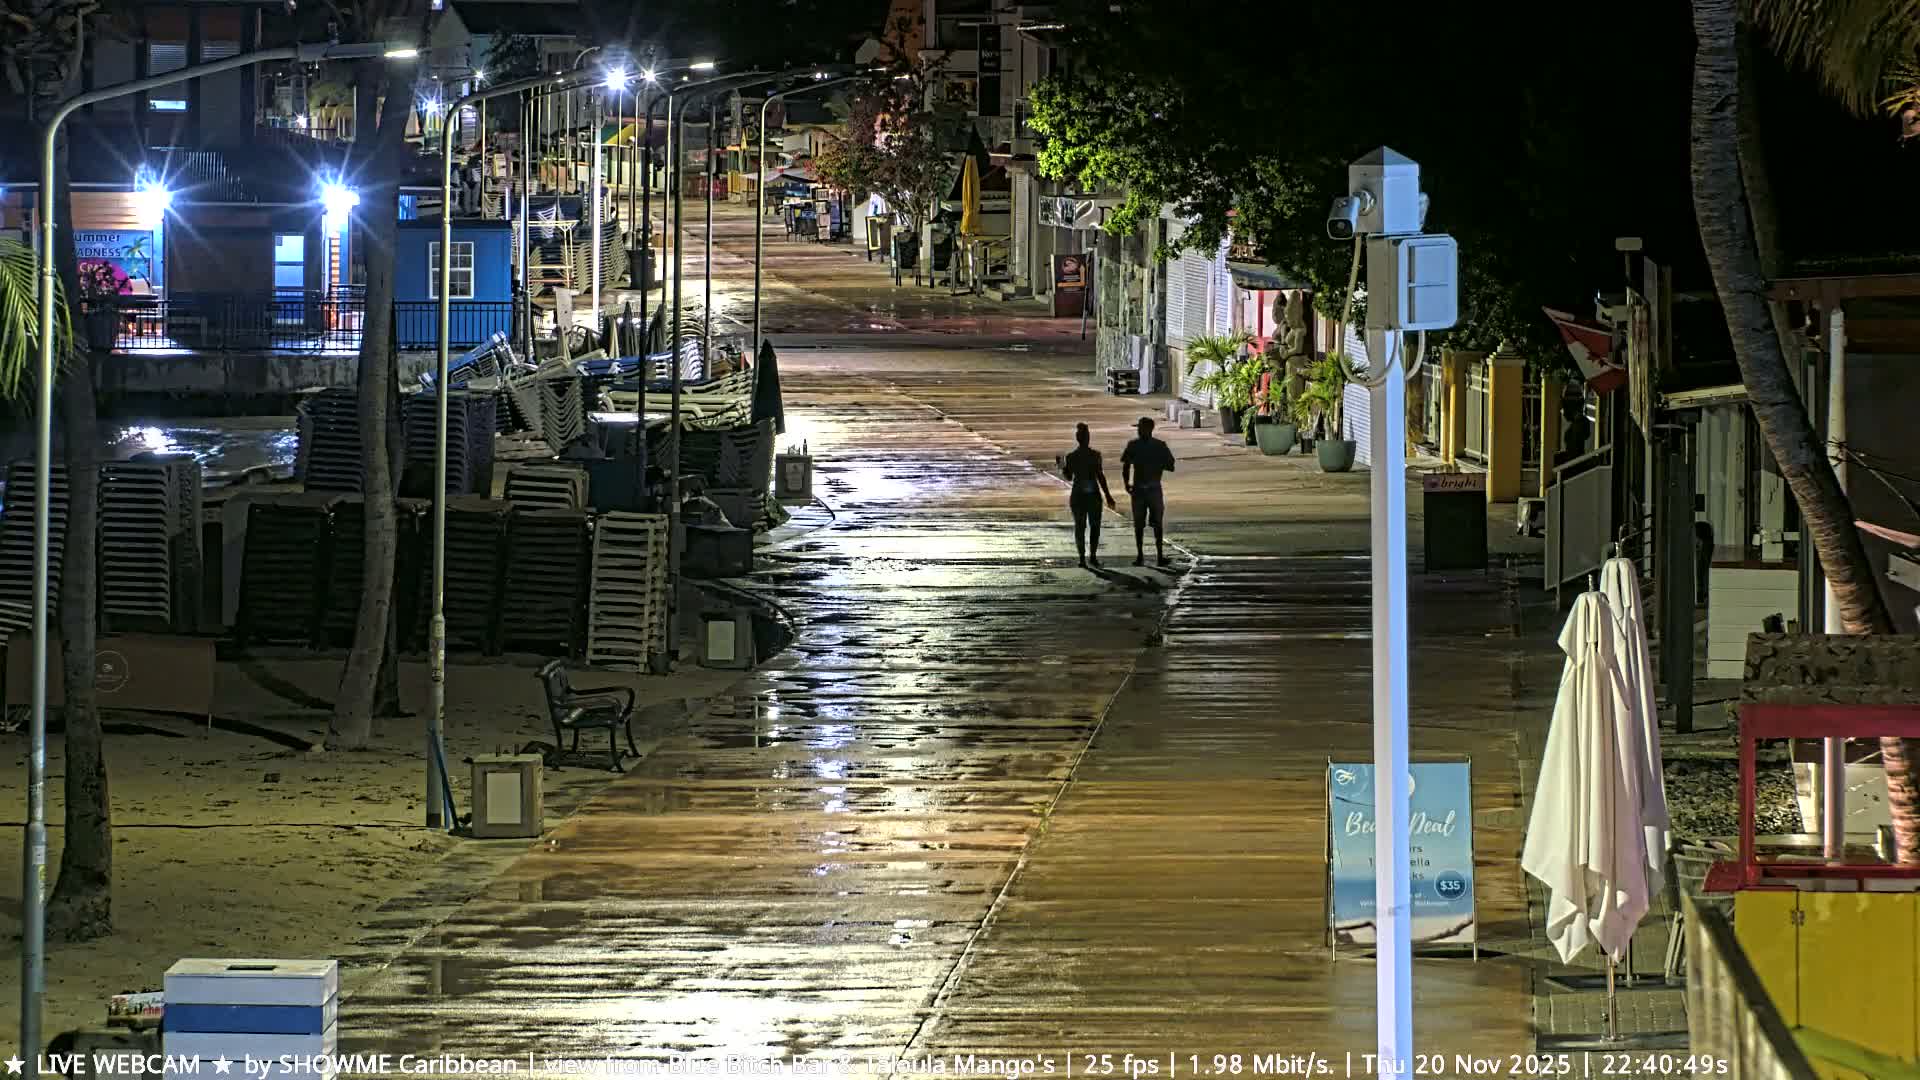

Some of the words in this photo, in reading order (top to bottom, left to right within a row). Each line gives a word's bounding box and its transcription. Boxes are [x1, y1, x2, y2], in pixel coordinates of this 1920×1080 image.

[74, 233, 121, 243] ummer
[76, 247, 121, 257] ADNESS
[1440, 880, 1461, 891] $35
